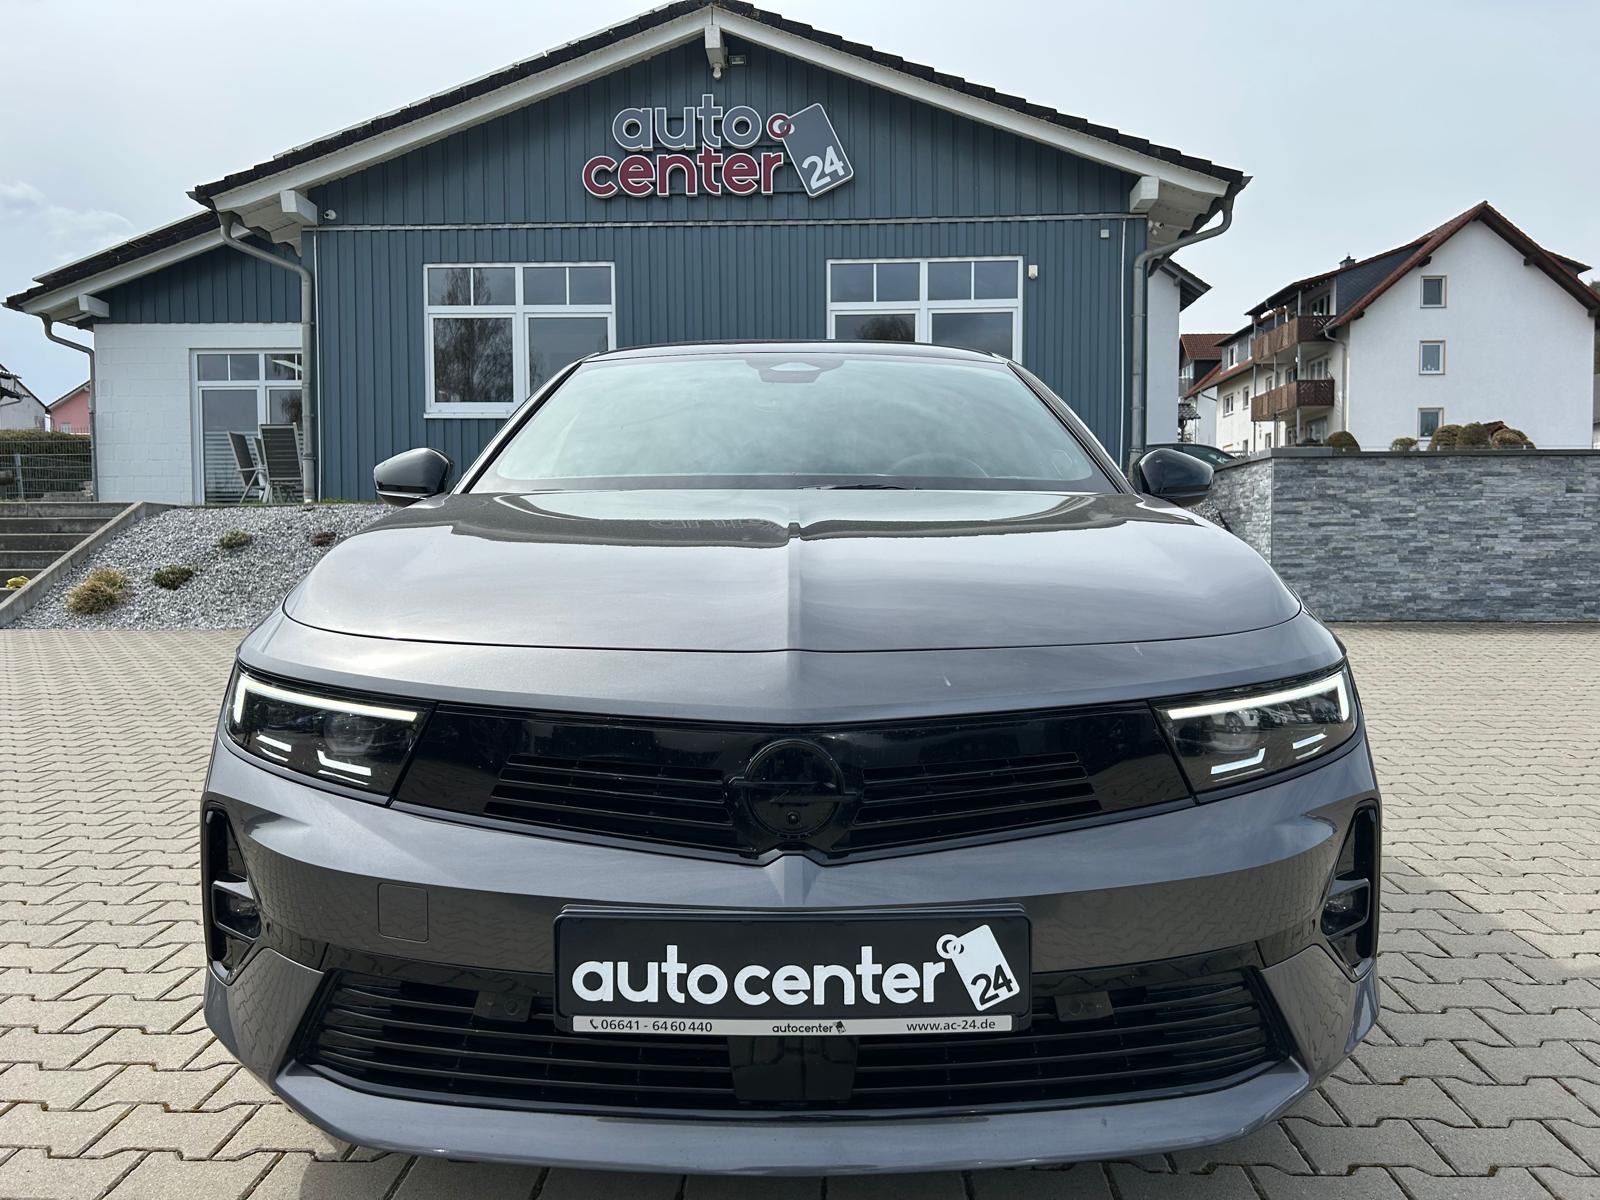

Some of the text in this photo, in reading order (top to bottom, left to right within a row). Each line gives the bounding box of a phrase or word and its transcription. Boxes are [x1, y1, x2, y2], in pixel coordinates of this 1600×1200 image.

[612, 94, 763, 151] auto
[582, 143, 784, 197] center
[801, 145, 845, 190] 24
[970, 964, 1013, 1006] 24
[600, 1019, 640, 1031] 06641
[772, 1023, 833, 1033] autocenter
[906, 1019, 996, 1031] www.ac-24.de
